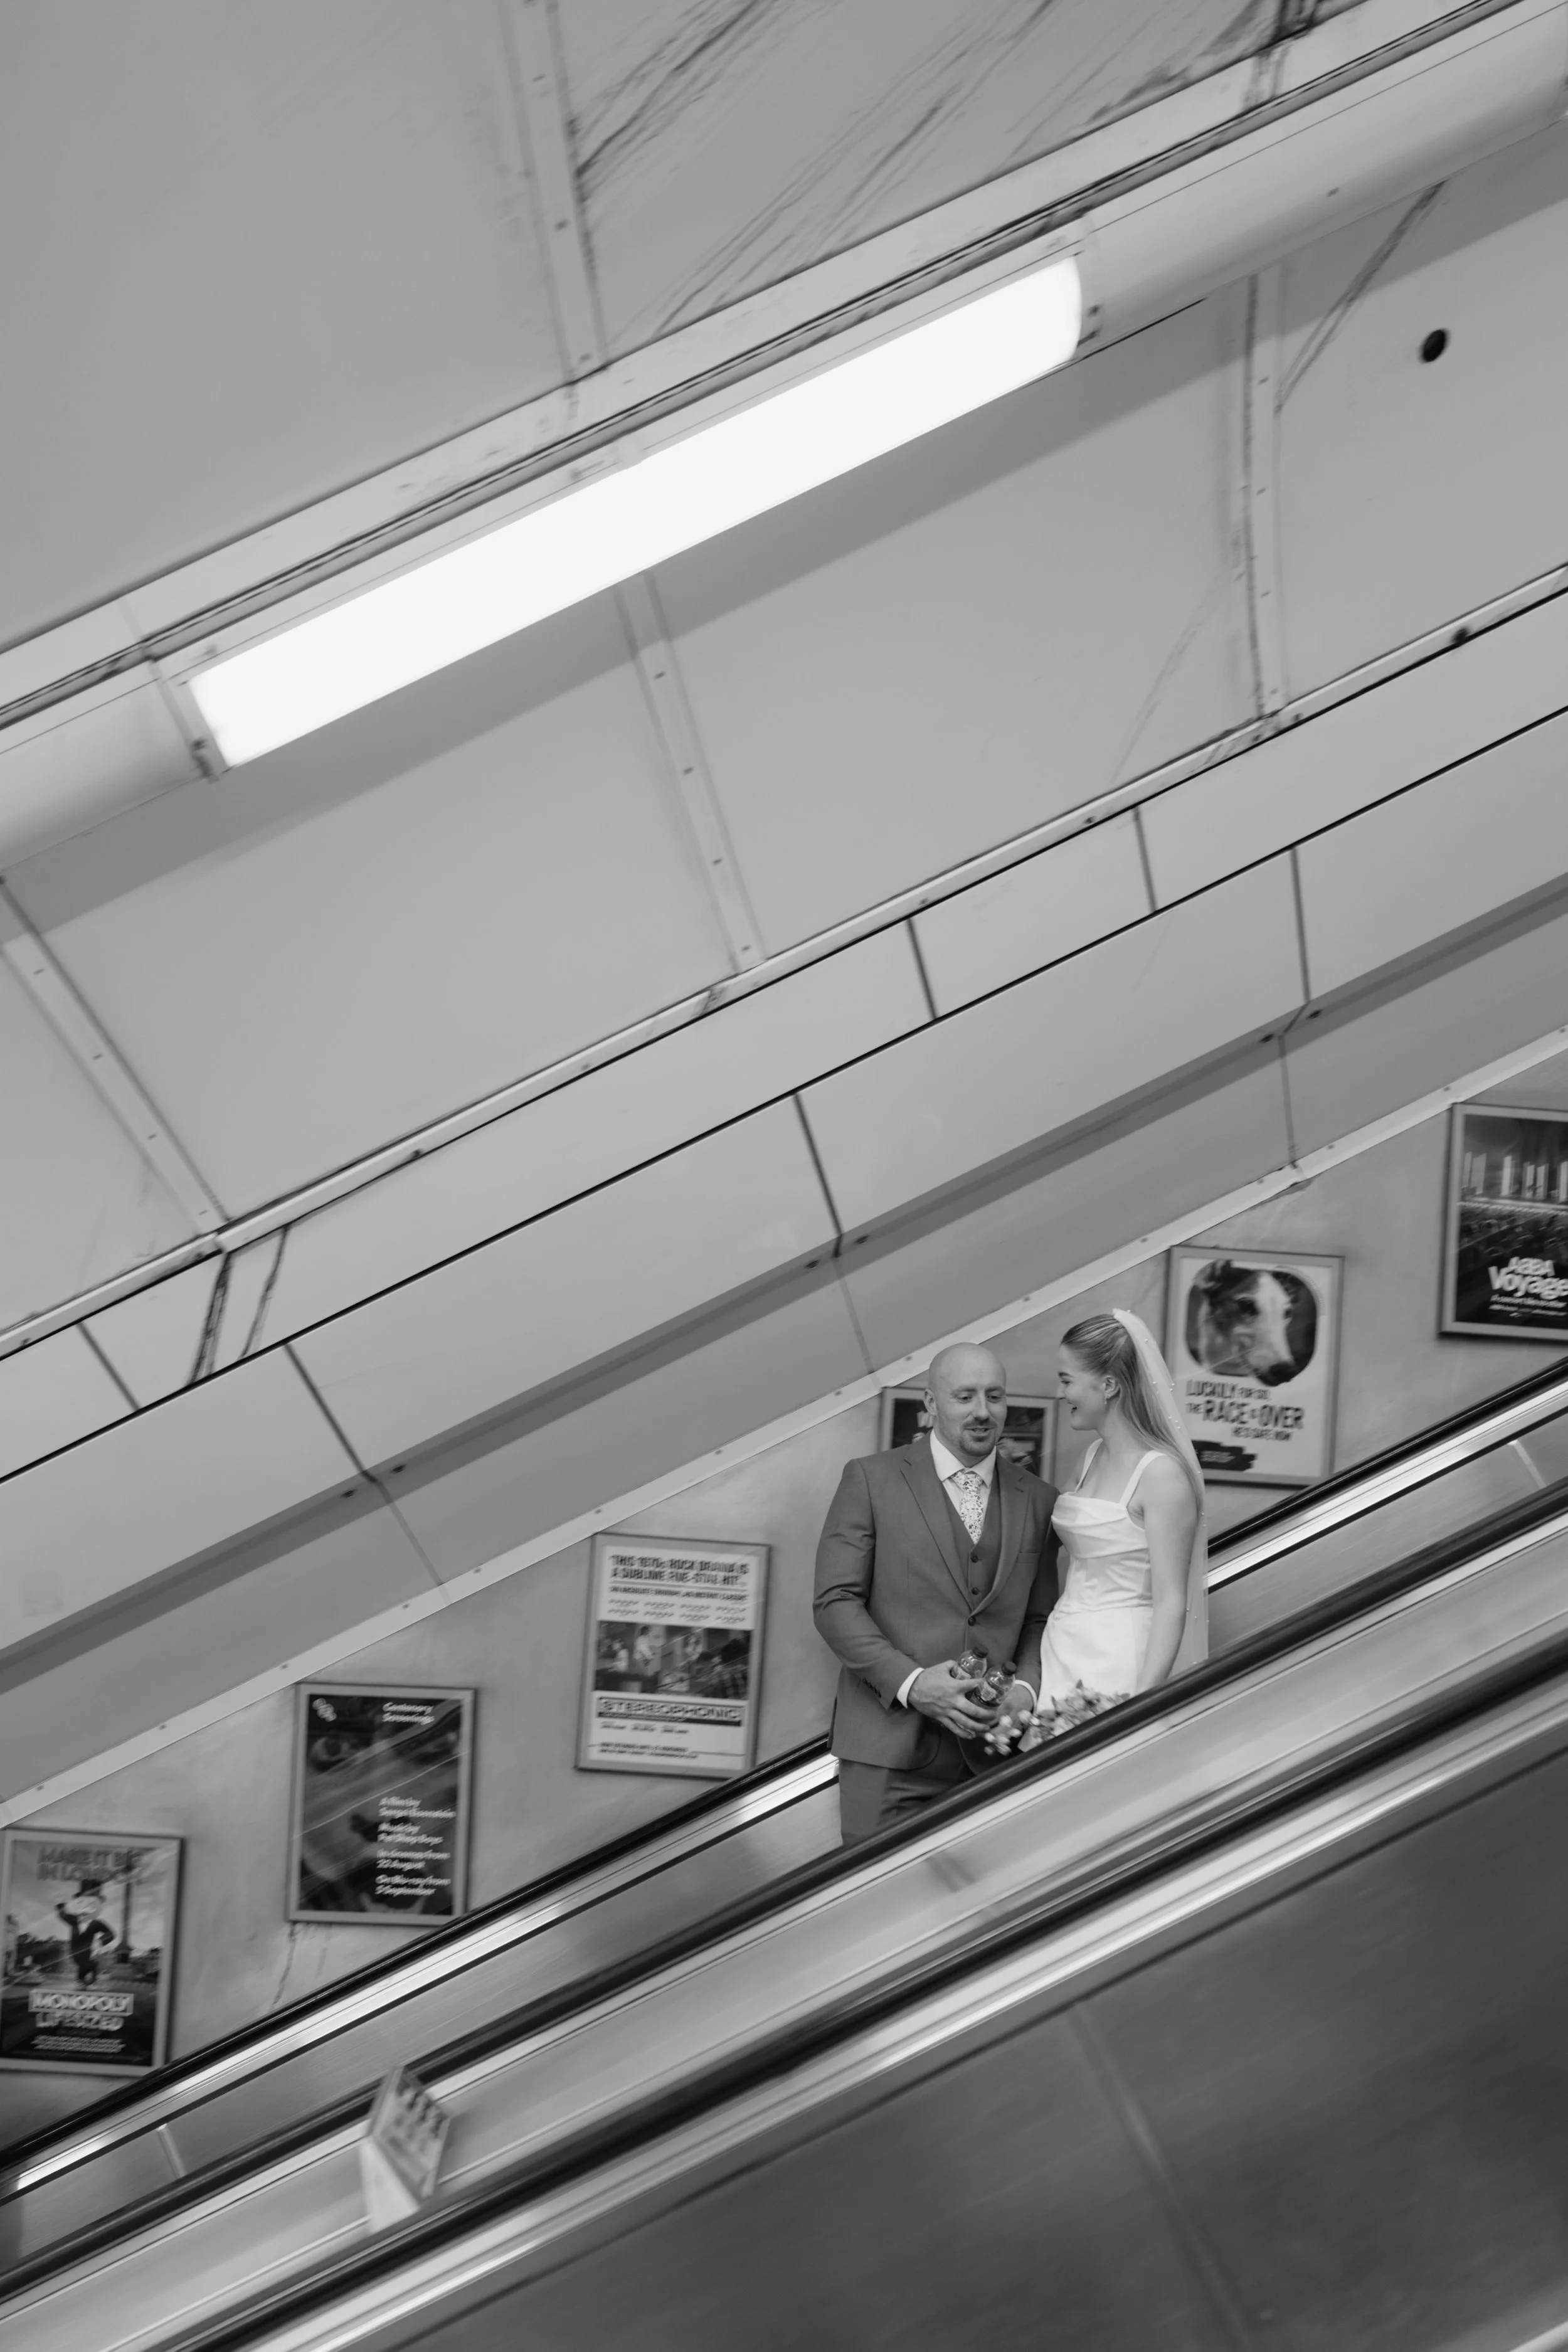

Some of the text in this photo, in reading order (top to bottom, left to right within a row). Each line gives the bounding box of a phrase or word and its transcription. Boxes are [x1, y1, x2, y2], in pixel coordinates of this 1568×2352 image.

[1488, 1266, 1568, 1300] Voyage
[1185, 1379, 1239, 1399] LUCKILY
[1185, 1402, 1203, 1414] THE
[1202, 1399, 1250, 1425] RACE
[1258, 1404, 1305, 1429] OVER
[601, 1700, 740, 1720] STEREOPHONIC
[33, 1993, 130, 2012] MONOPOLY
[35, 2011, 124, 2032] LIFESIZED
